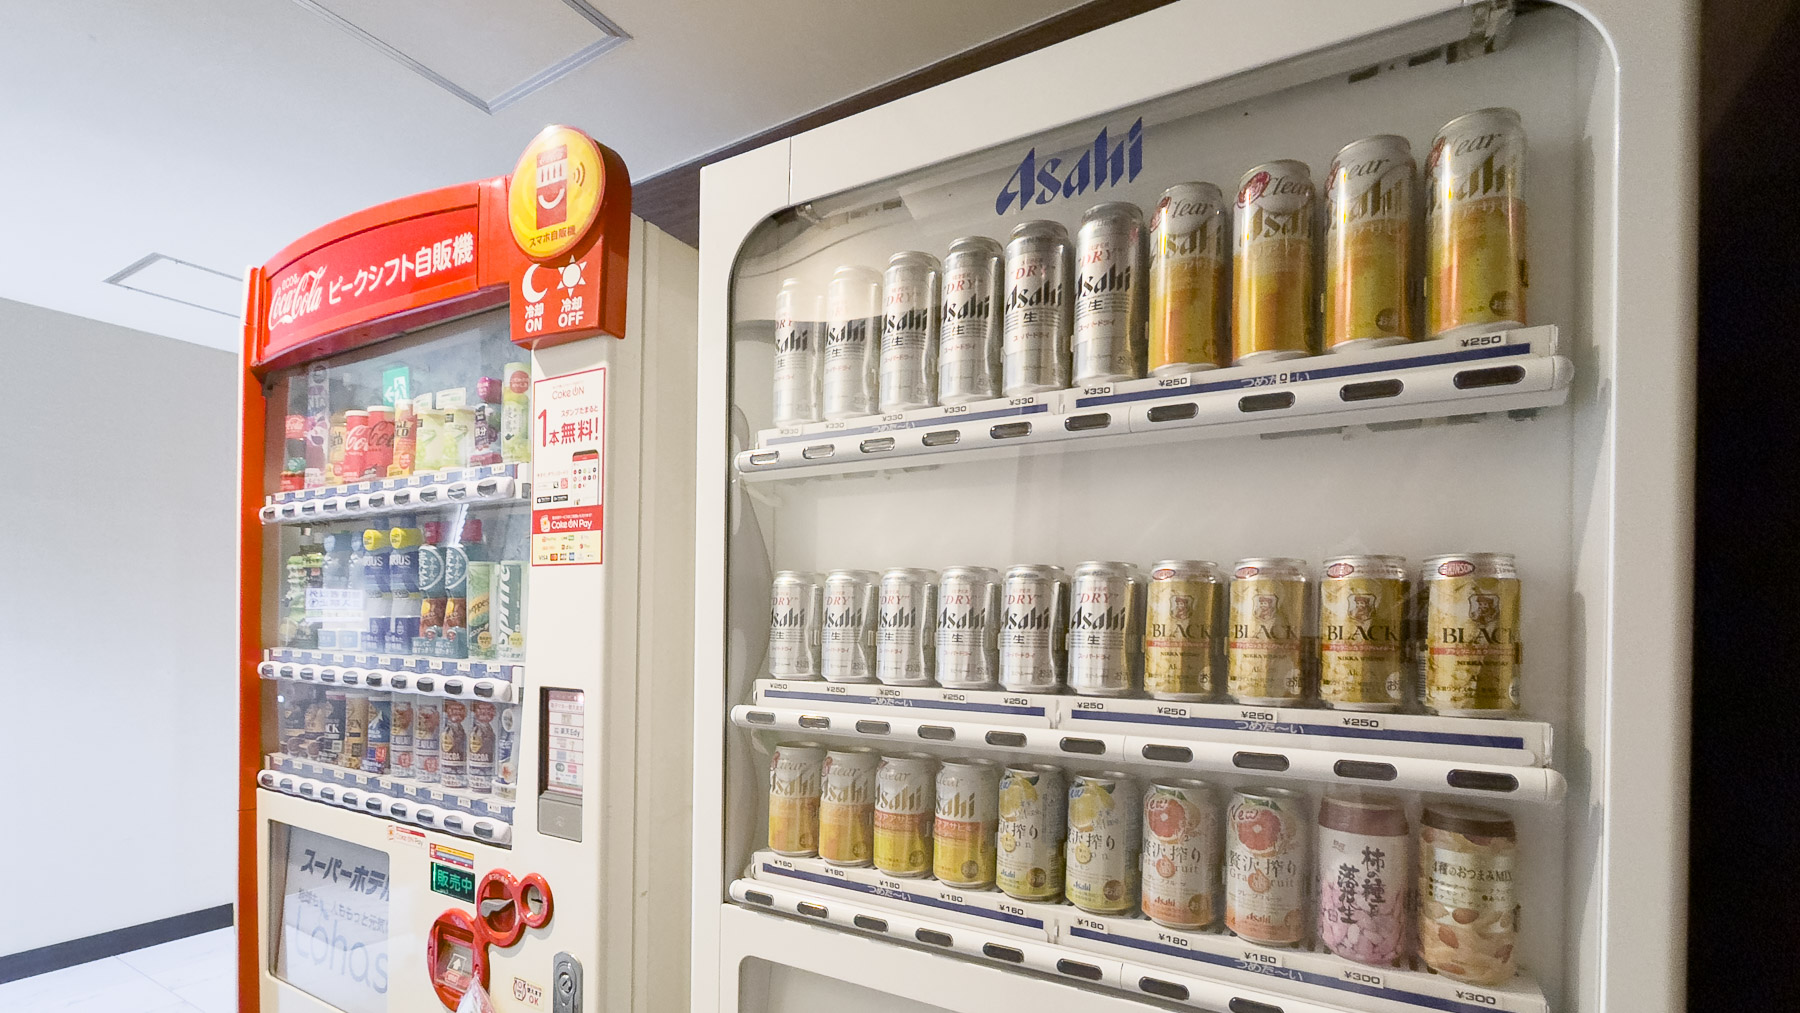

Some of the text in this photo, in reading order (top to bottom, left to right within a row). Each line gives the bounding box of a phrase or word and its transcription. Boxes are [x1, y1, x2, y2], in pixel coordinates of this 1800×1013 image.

[995, 116, 1143, 216] Asahi
[529, 225, 576, 248] スマホ自販機
[329, 231, 474, 305] ピークシフト自販機
[1074, 263, 1131, 300] Asahi
[1005, 280, 1063, 315] Asahi
[525, 302, 544, 319] 冷却
[561, 296, 583, 313] 冷却
[525, 317, 543, 334] ON
[558, 311, 585, 328] OFF
[1461, 335, 1502, 347] ¥250
[1159, 377, 1188, 387] ¥250
[552, 389, 571, 400] Coke
[1083, 386, 1111, 396] ¥330
[1009, 397, 1034, 406] ¥330
[561, 405, 599, 417] スタンプたまると
[944, 405, 967, 414] ¥330
[882, 413, 904, 422] ¥330
[579, 518, 593, 530] Pay
[937, 606, 986, 630] Asahi
[1000, 606, 1050, 631] Asahi
[1070, 605, 1126, 631] Asahi
[1152, 623, 1211, 639] BLACK
[1234, 624, 1297, 639] BLACK
[1327, 625, 1401, 642] BLACK
[826, 686, 846, 694] ¥250
[879, 688, 901, 697] ¥250
[942, 693, 965, 701] ¥250
[1003, 697, 1028, 706] ¥250
[1076, 702, 1104, 710] ¥250
[1157, 706, 1187, 716] ¥250
[1241, 711, 1274, 721] ¥250
[1343, 717, 1379, 728] ¥250
[935, 792, 976, 820] sahi
[1229, 803, 1259, 821] New
[999, 821, 1039, 841] 沢搾り
[774, 859, 793, 868] ¥180
[1228, 850, 1297, 877] 贅沢搾り
[825, 867, 845, 877] ¥180
[437, 868, 473, 895] 販売中
[879, 879, 901, 889] ¥180
[1073, 881, 1091, 892] Asahi
[940, 892, 963, 903] ¥180
[1337, 863, 1363, 925] 落花生
[1154, 895, 1176, 907] Asahi
[1077, 918, 1105, 931] ¥180
[1246, 912, 1271, 924] Asahi
[1158, 932, 1189, 947] ¥180
[295, 903, 389, 995] Lohas
[1244, 951, 1277, 964] ¥180
[1343, 970, 1381, 985] ¥300
[528, 994, 539, 1006] OK
[1455, 990, 1497, 1005] ¥300
